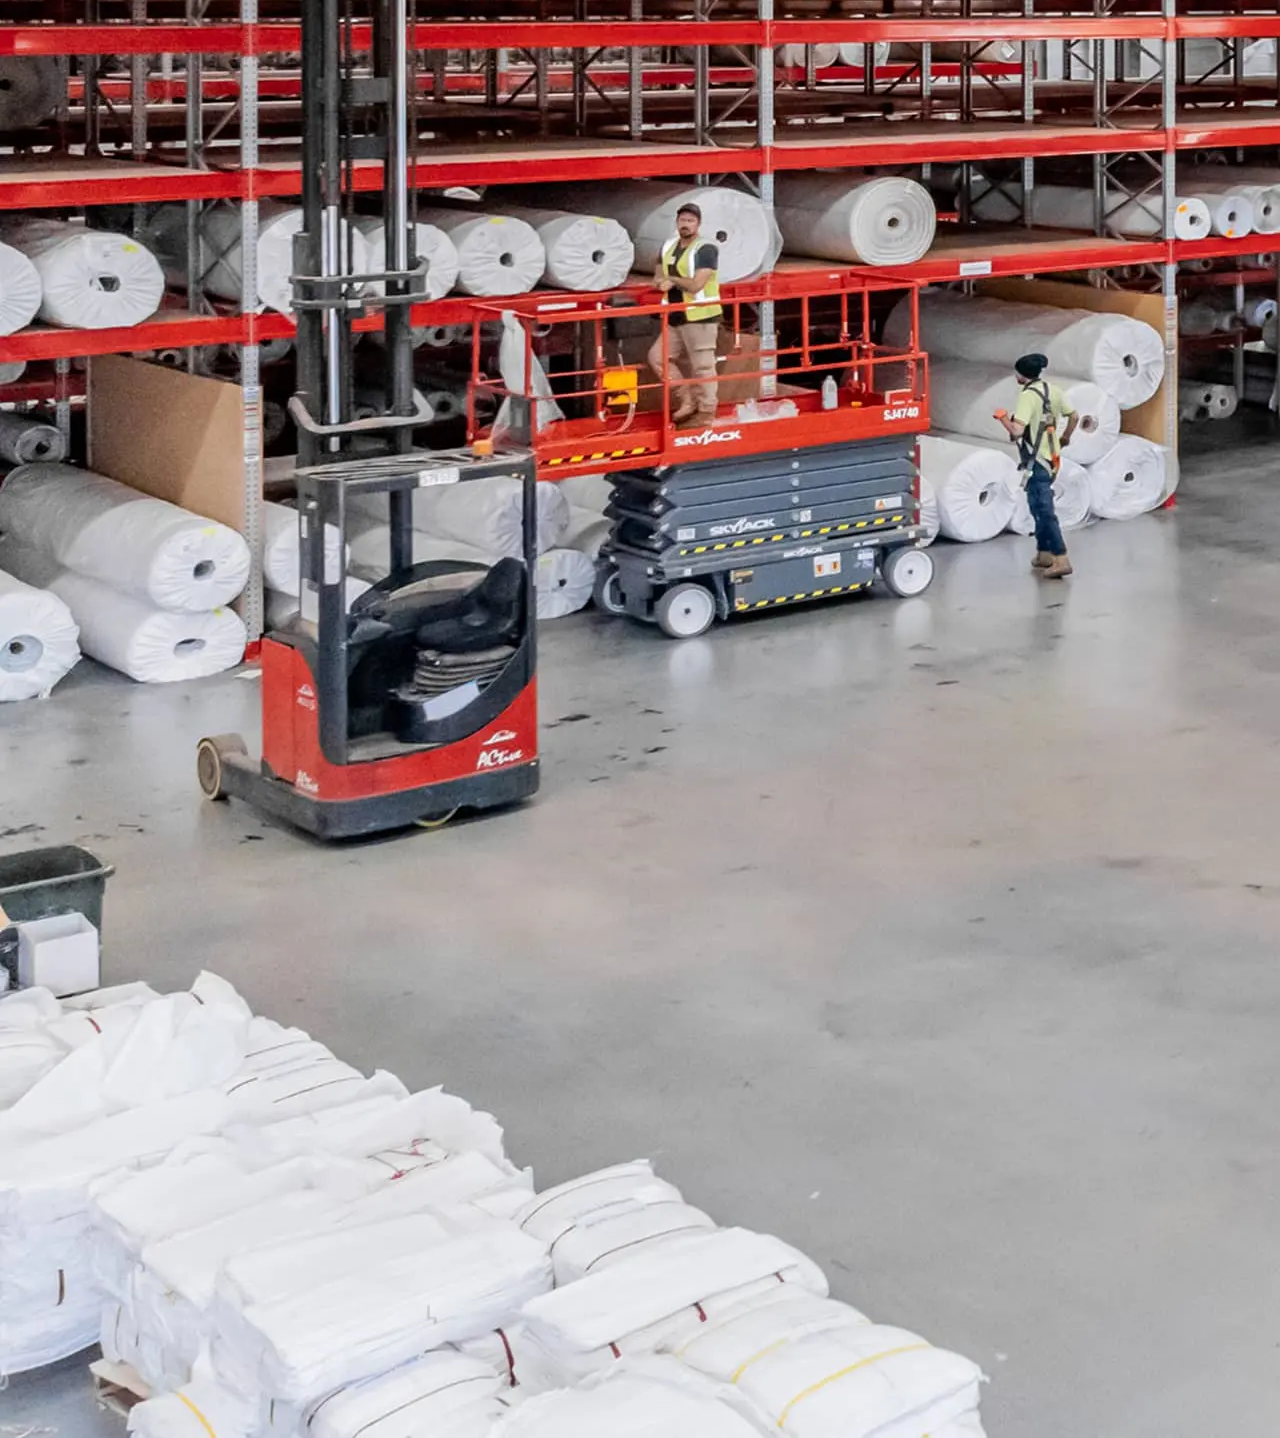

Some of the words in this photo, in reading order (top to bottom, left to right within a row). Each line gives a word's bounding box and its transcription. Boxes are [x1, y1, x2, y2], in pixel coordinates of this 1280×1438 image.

[883, 406, 919, 422] SJ4740
[673, 429, 742, 447] SKYJACK
[709, 517, 776, 537] SKYJACK
